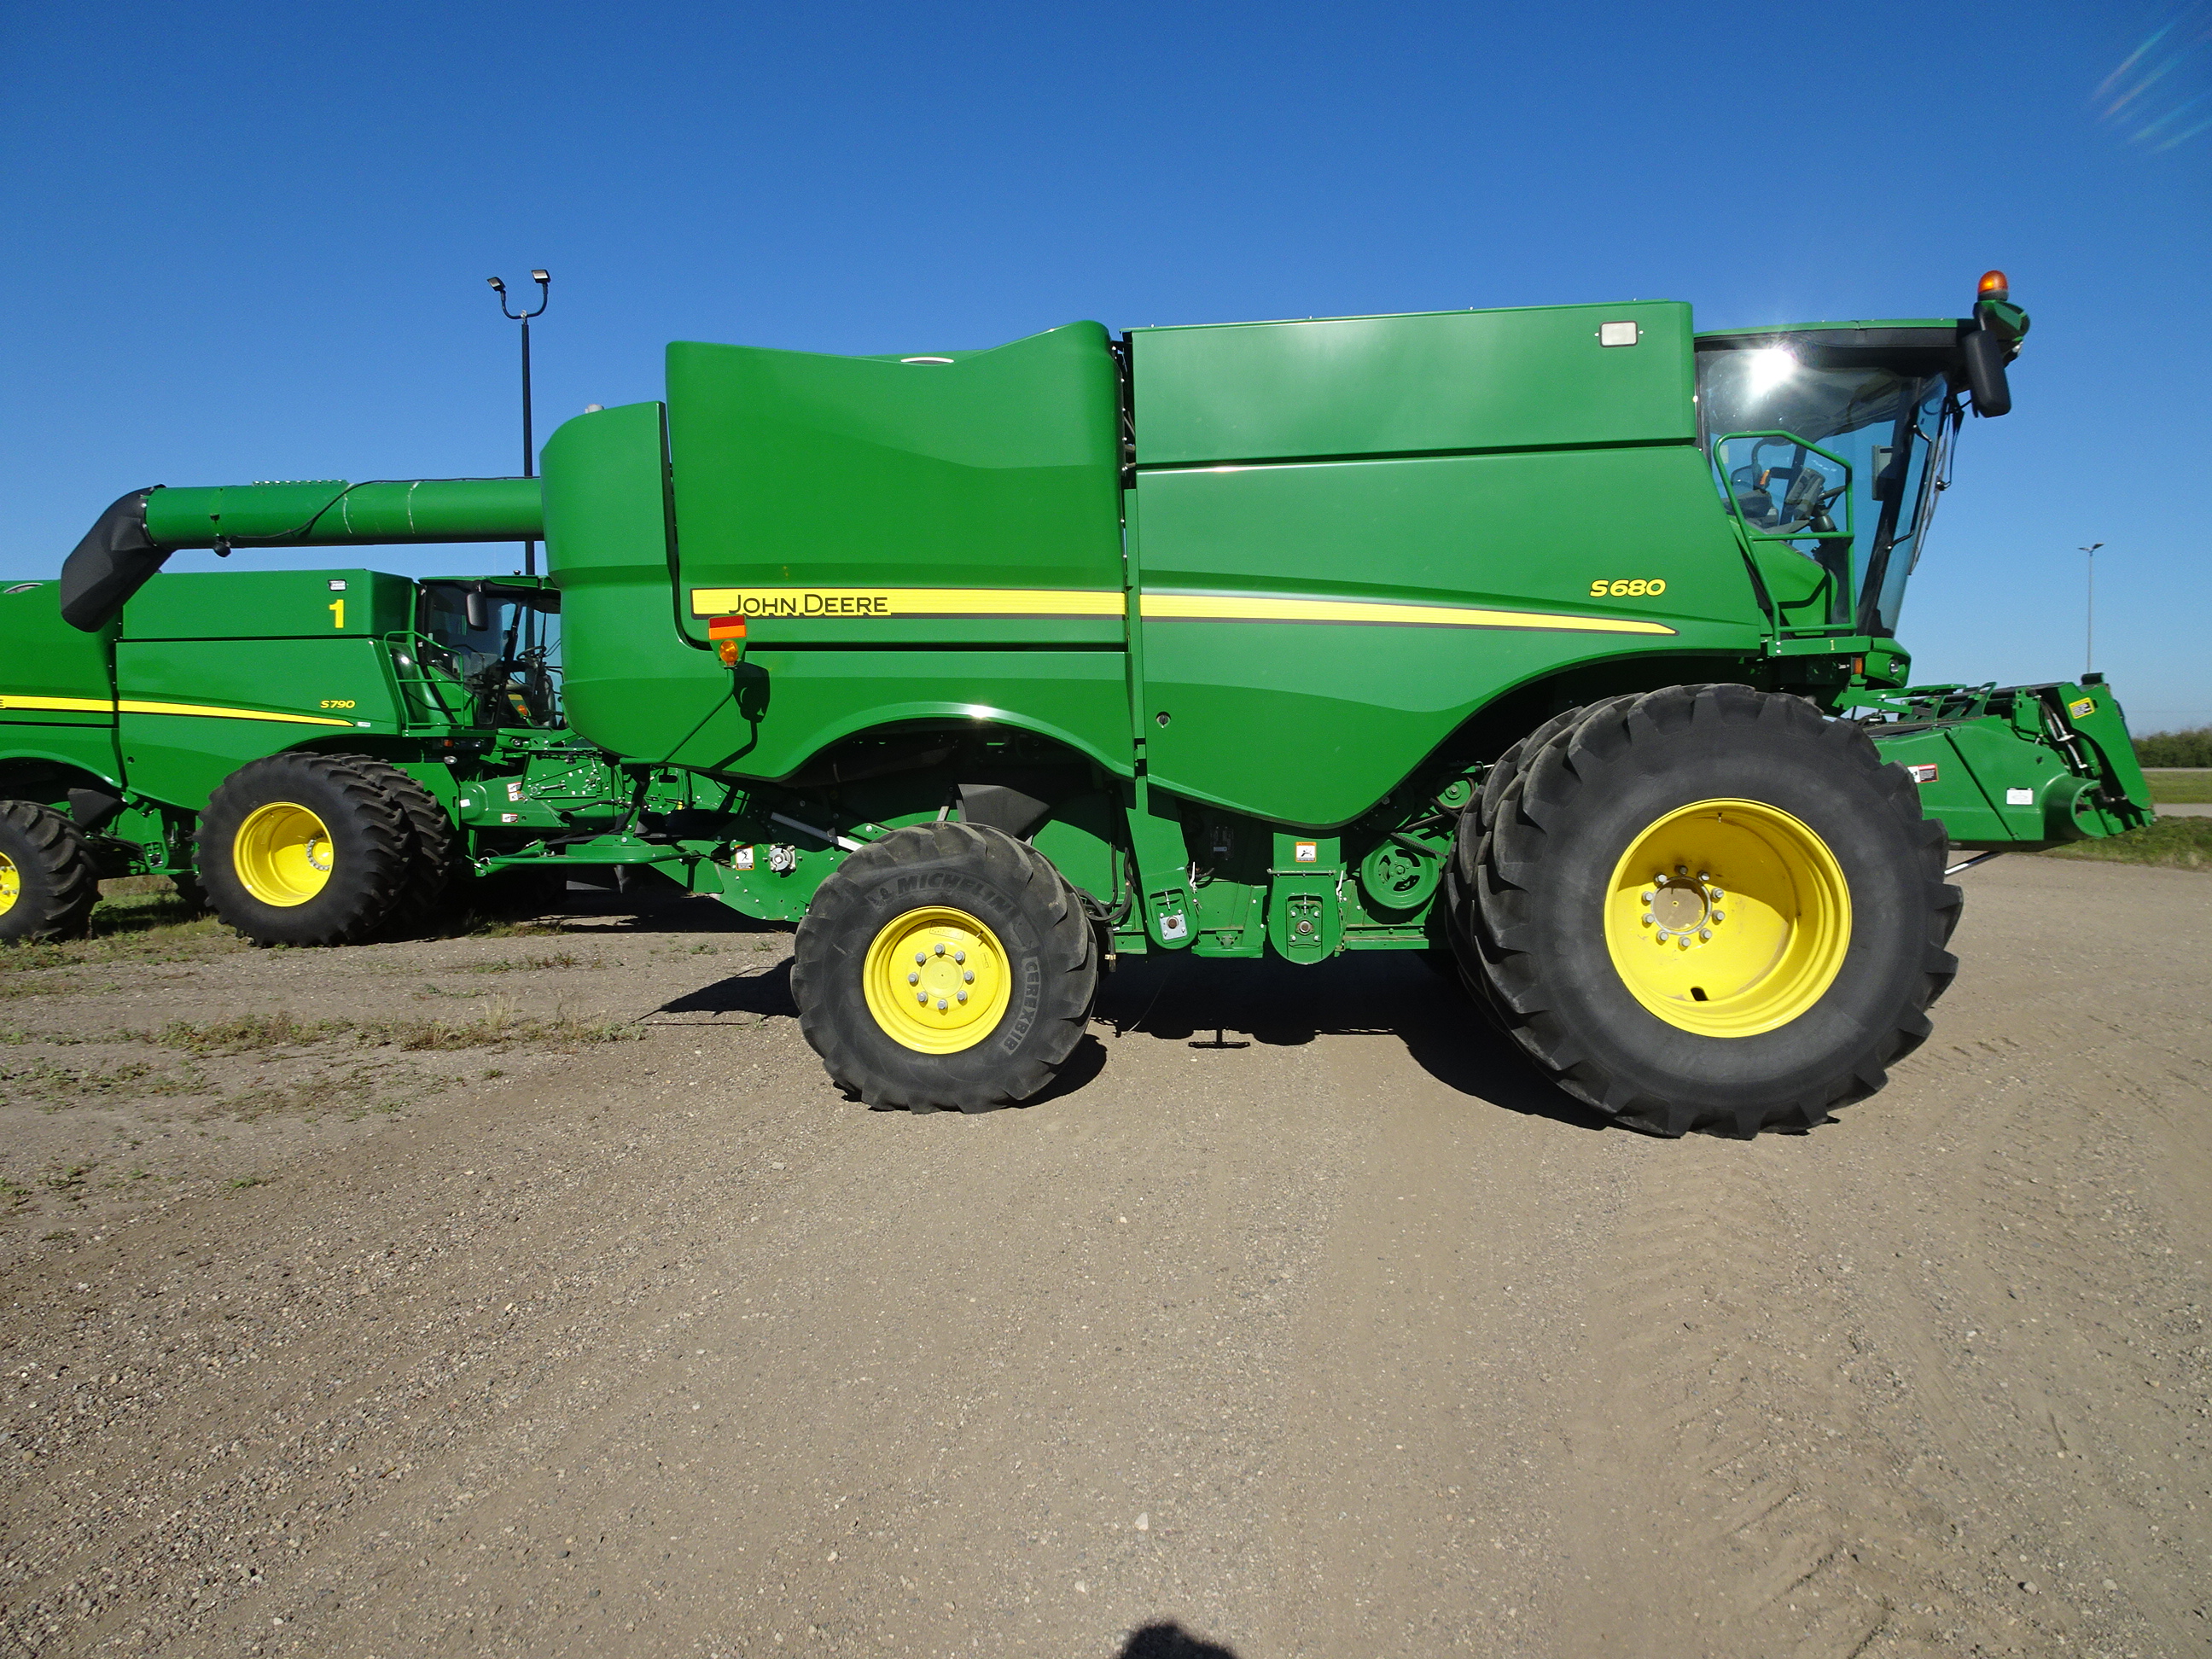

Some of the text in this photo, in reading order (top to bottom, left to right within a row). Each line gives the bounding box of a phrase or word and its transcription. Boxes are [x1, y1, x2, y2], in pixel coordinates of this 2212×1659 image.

[1589, 578, 1667, 597] S680
[329, 598, 344, 628] 1
[729, 594, 888, 614] JOHN DEERE
[320, 700, 356, 709] S790
[897, 871, 1013, 912] MICHELIN
[1004, 961, 1039, 1051] CEREXBIB
